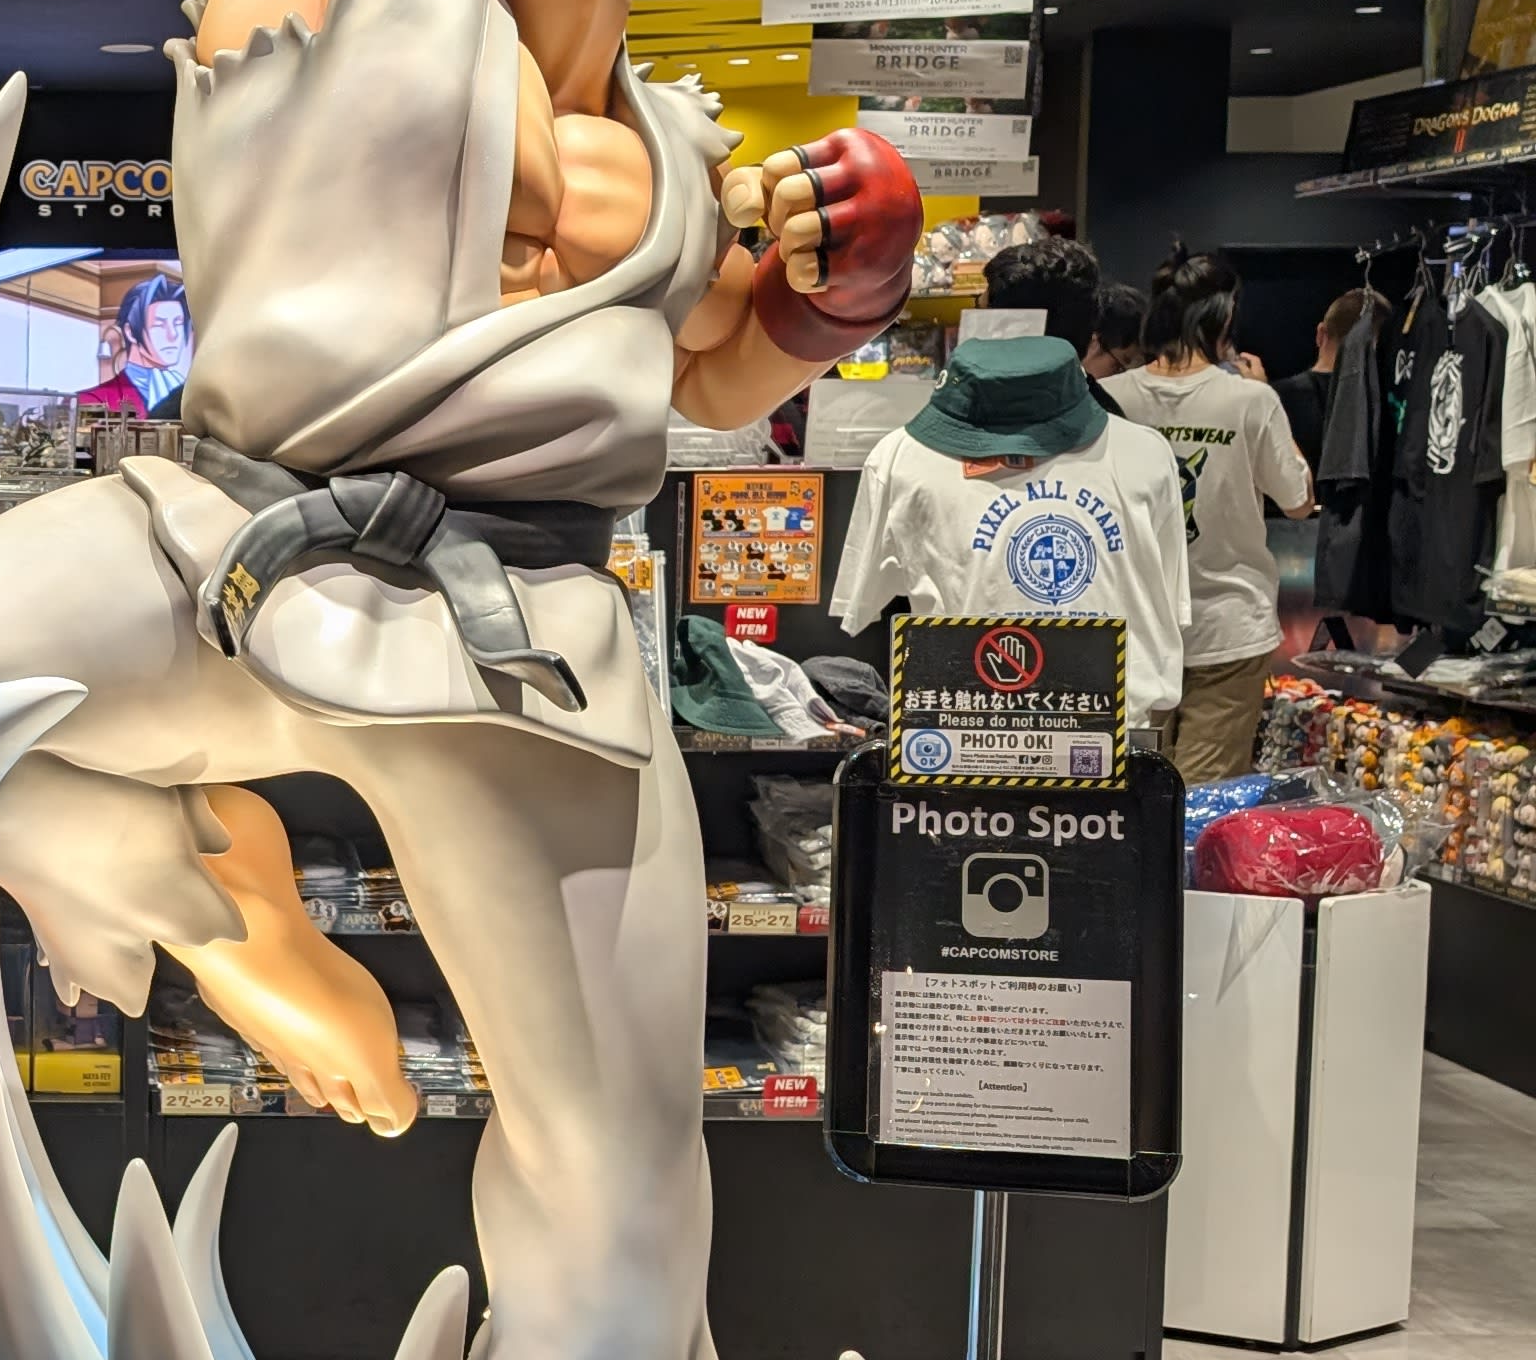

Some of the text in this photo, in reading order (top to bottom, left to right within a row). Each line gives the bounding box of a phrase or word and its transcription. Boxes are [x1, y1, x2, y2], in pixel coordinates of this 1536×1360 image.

[875, 55, 960, 70] BRIDGE
[1472, 101, 1520, 126] DOGMA
[909, 125, 977, 137] BRIDGE
[934, 167, 993, 177] BRIDGE
[20, 159, 174, 201] CAPCO
[38, 204, 162, 217] STOR
[1156, 426, 1236, 446] ORTSWEAR
[972, 480, 1124, 552] PIXEL ALL STARS
[1034, 525, 1069, 537] CAPCOM
[736, 607, 768, 619] NEW
[735, 623, 768, 635] ITEM
[904, 689, 1111, 712] お手を触れないでください
[939, 714, 1082, 729] Please do not touch.
[961, 733, 1053, 750] PHOTO OK!
[920, 758, 937, 766] OK
[892, 801, 1125, 846] Photo Spot
[808, 914, 829, 925] ITE
[941, 946, 1059, 962] #CAPCOMSTORE
[774, 1078, 808, 1090] NEW
[773, 1095, 808, 1108] ITEM
